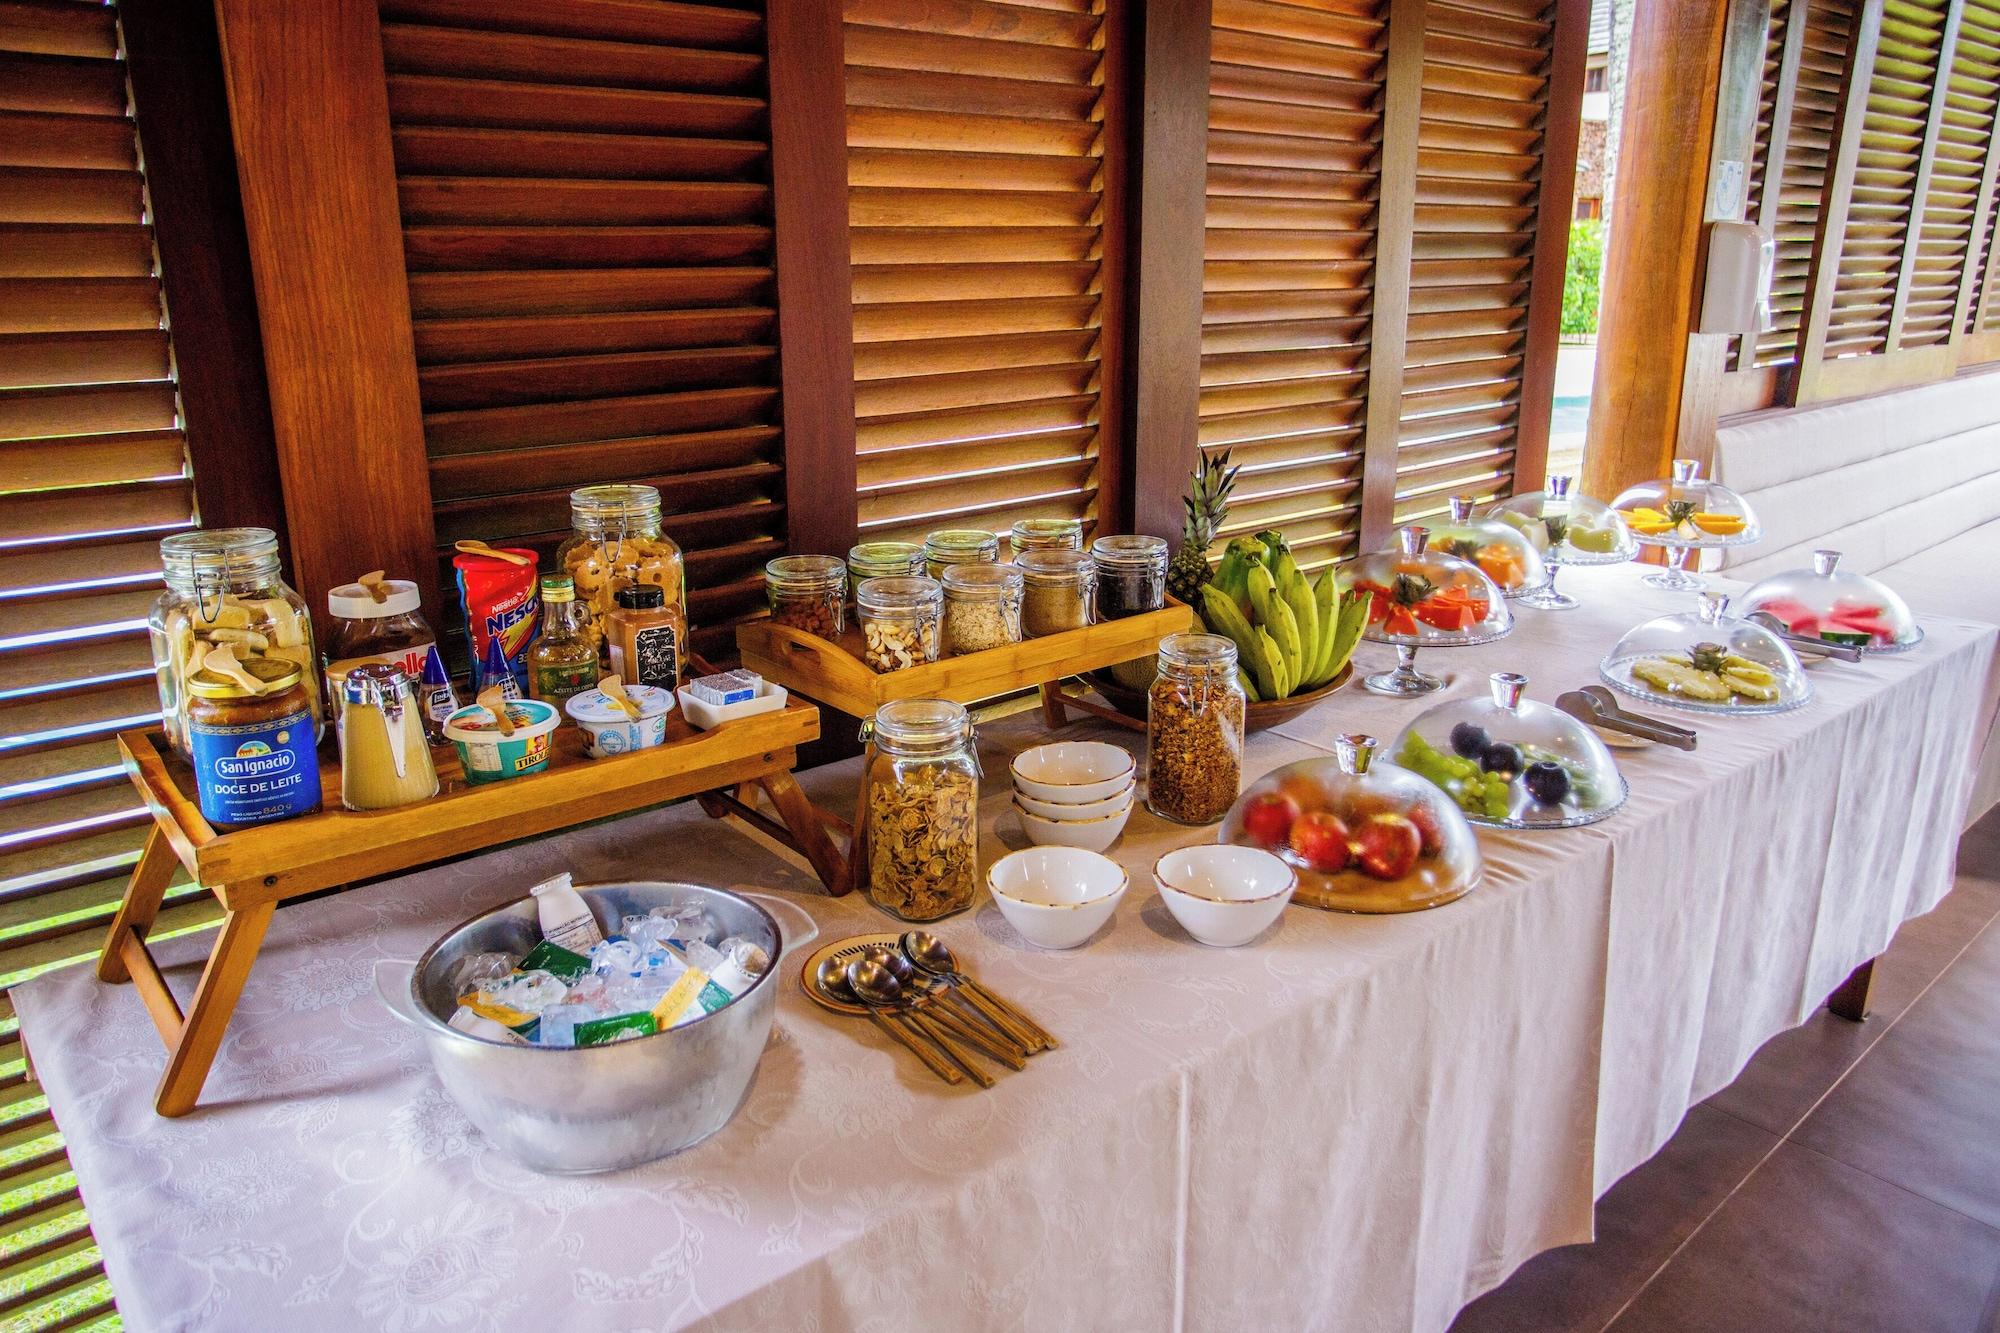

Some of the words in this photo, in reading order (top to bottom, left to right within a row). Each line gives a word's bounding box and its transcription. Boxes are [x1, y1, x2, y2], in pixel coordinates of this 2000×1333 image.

[214, 784, 248, 795] DOCE
[250, 782, 268, 793] DE
[271, 773, 302, 790] LEITE
[263, 804, 284, 814] 840
